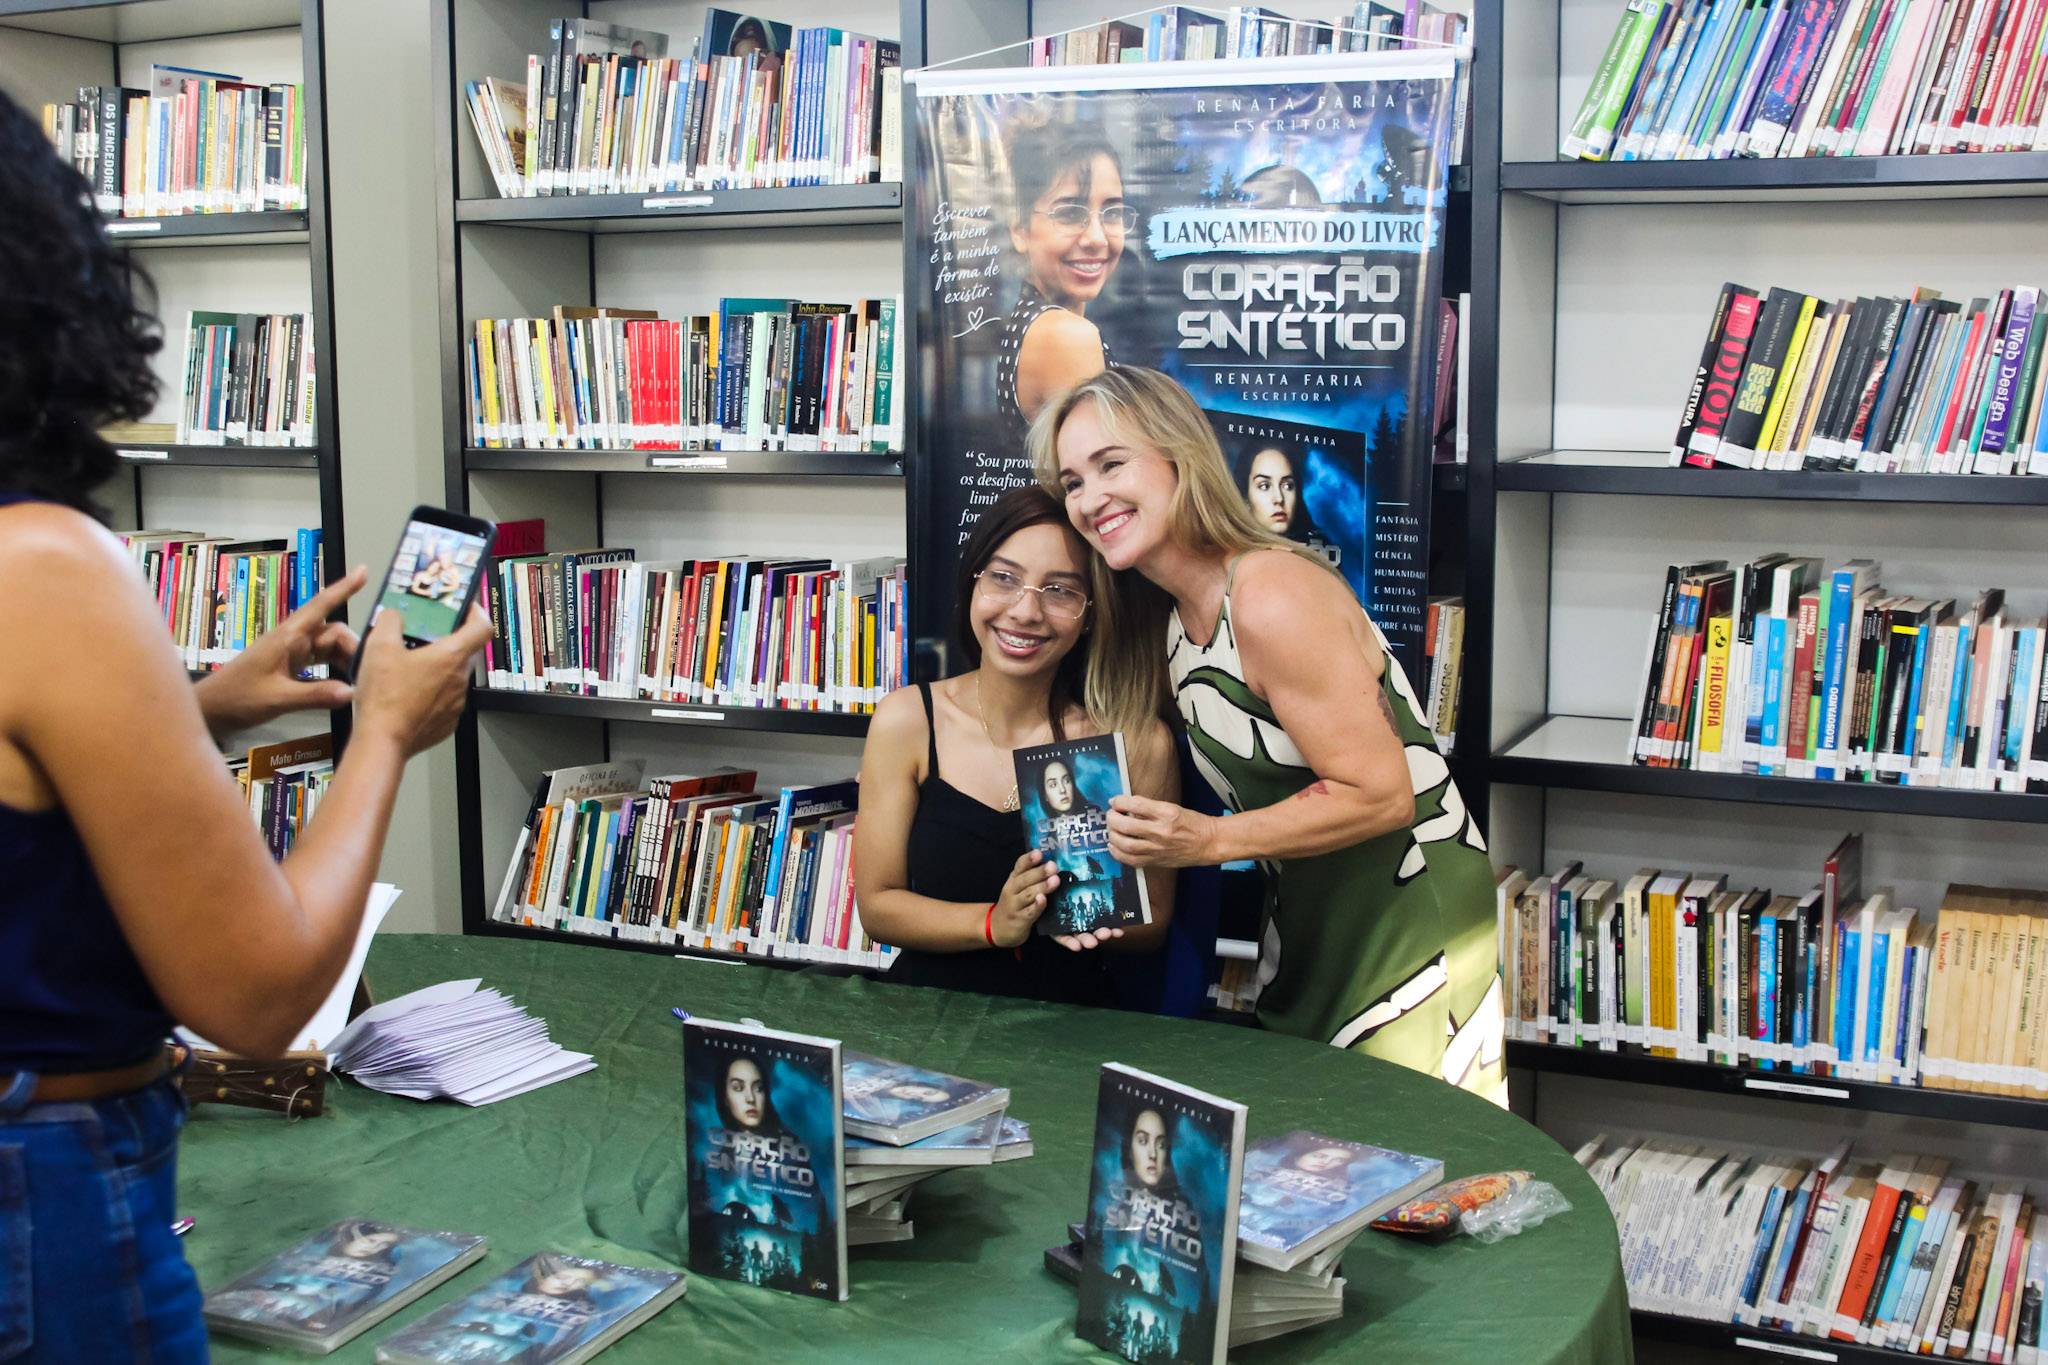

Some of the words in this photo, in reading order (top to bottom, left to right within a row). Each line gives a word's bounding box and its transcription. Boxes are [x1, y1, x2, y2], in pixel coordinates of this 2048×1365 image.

[105, 102, 116, 119] OS
[1197, 97, 1294, 113] RENATA
[1318, 94, 1395, 110] FARIA
[690, 128, 699, 146] VIDA
[1234, 118, 1356, 133] ESCRITORA
[102, 121, 115, 200] VENCEDORES
[933, 201, 991, 225] Escrever
[933, 224, 988, 244] também
[1163, 221, 1317, 248] LANÇAMENTO
[1324, 221, 1355, 243] DO
[1361, 220, 1426, 243] LIVRO
[930, 249, 939, 264] é
[943, 251, 953, 262] a
[957, 239, 1000, 260] minha
[935, 265, 980, 291] forma
[984, 258, 1000, 277] de
[1182, 256, 1400, 311] CORAÇÃO
[944, 282, 993, 303] existir.
[782, 339, 790, 347] DE
[1177, 304, 1406, 360] SINTÉTICO
[2002, 323, 2026, 362] Web
[1215, 372, 1288, 386] RENATA
[1304, 373, 1363, 387] FARIA
[1697, 365, 1708, 376] A
[1242, 391, 1331, 402] ESCRITORA
[1696, 335, 1748, 435] IDIOT
[1986, 362, 2017, 424] Design
[1681, 376, 1705, 429] LEITURA
[1228, 423, 1285, 440] RENATA
[1295, 433, 1336, 447] FARIA
[960, 475, 973, 486] os
[977, 472, 1026, 491] desafios
[1375, 515, 1419, 525] FANTASIA
[579, 551, 634, 567] MITOLOGIA
[1375, 549, 1412, 561] CIÊNCIA
[563, 560, 575, 603] MITOLOGIA
[1374, 586, 1379, 595] E
[1384, 586, 1416, 596] MUITAS
[553, 574, 562, 616] MITOLOGIA
[566, 603, 577, 629] GREGA
[1373, 602, 1421, 615] REFLEXÕES
[1806, 605, 1818, 635] Chaui
[555, 616, 563, 642] GREGA
[1401, 621, 1408, 631] A
[1796, 604, 1808, 649] Marilena
[1814, 626, 1829, 667] Filosofia
[1707, 665, 1724, 727] FILOSOFIA
[1790, 669, 1813, 746] Filosofia
[1821, 686, 1841, 749] FILOSOFANDO
[270, 755, 292, 767] Mato
[294, 749, 322, 761] Grosso
[1026, 751, 1062, 761] RENATA
[1069, 745, 1100, 755] FARIA
[794, 800, 844, 816] MODERNOS
[1038, 809, 1108, 838] CORAÇÃO
[1040, 829, 1110, 852] SINTÉTICO
[1759, 939, 1768, 971] FUTURO
[1822, 946, 1830, 981] MAGIA
[1757, 974, 1767, 1028] ASTROLÓGICO
[705, 1038, 756, 1053] RENATA
[708, 1127, 811, 1164] CORAÇÃO
[707, 1153, 814, 1187] SINTÉTICO
[1940, 1304, 1956, 1338] NOSSO
[1949, 1285, 1962, 1306] LAR
